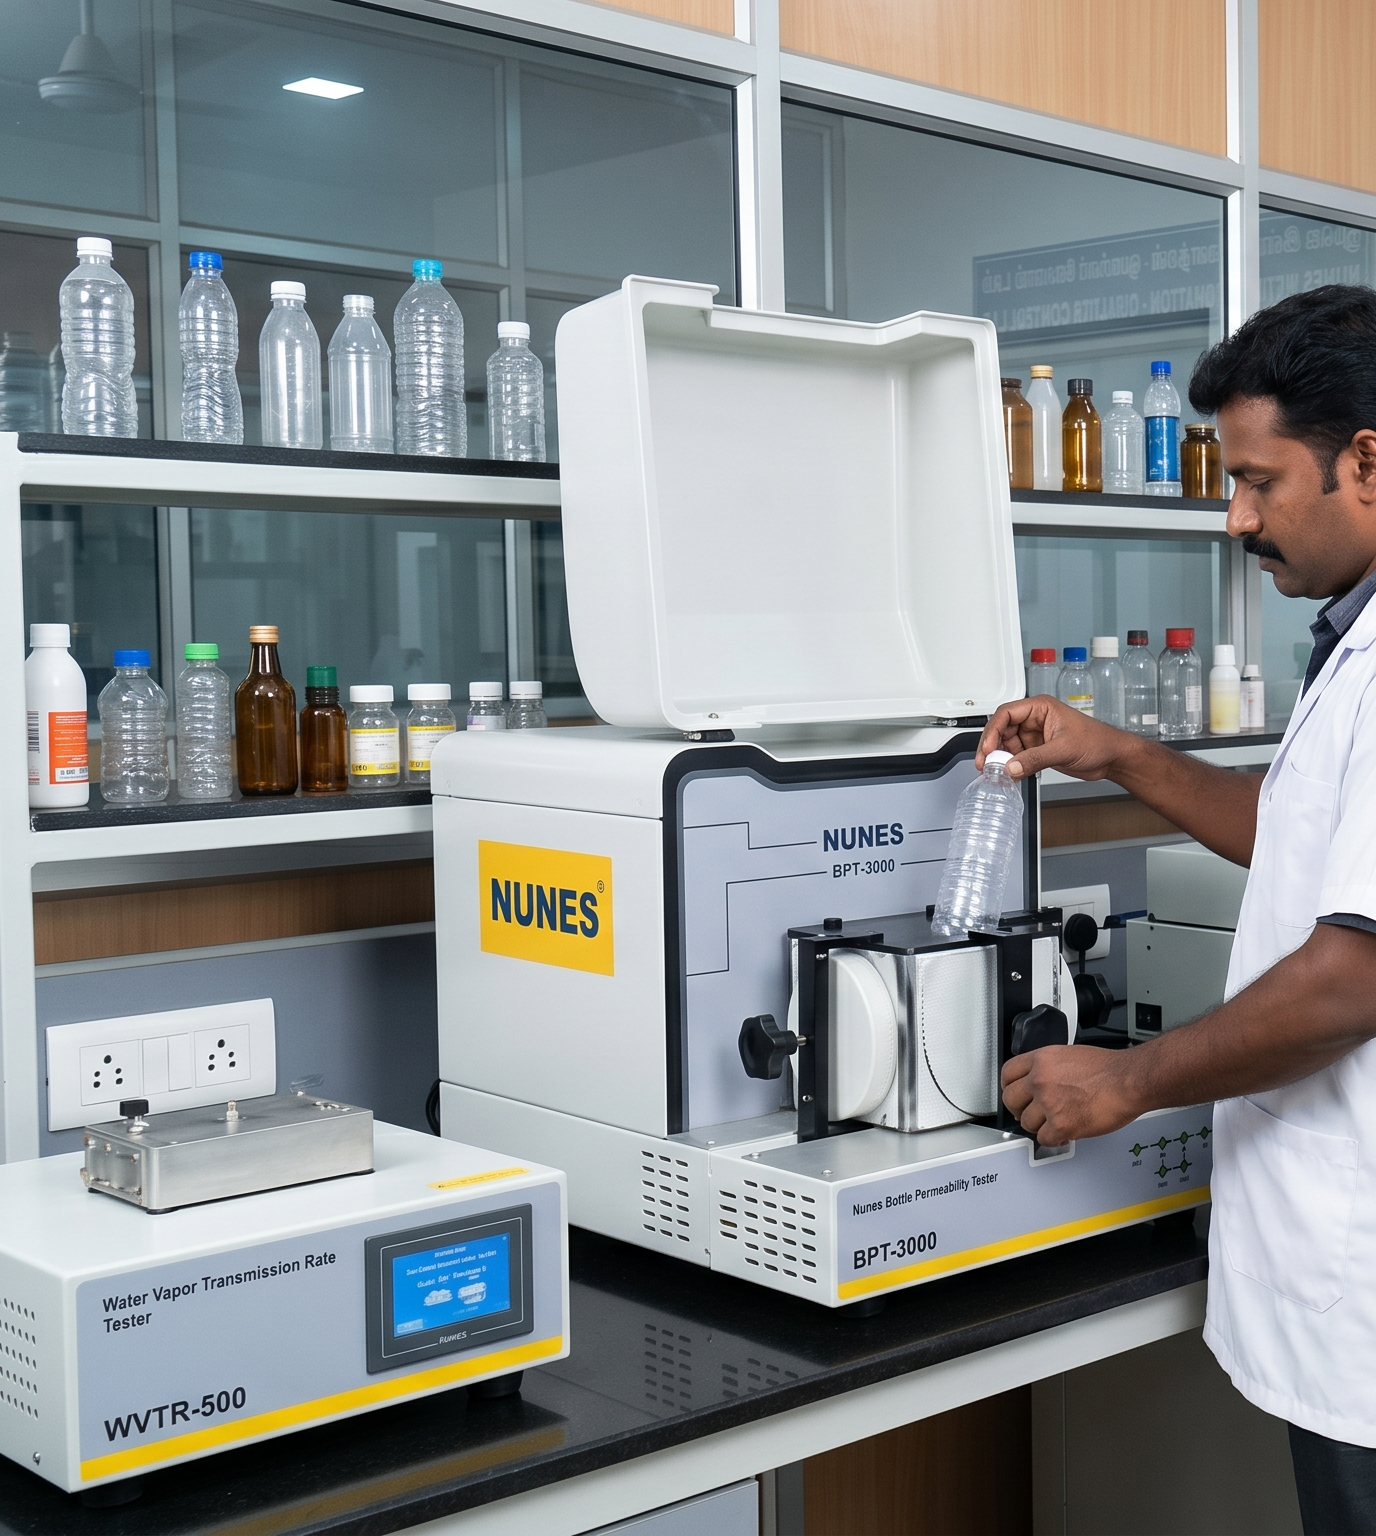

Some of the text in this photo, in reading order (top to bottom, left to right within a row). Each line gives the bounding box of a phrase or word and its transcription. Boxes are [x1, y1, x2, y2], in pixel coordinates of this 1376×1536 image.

[823, 823, 904, 853] NUNES
[832, 858, 895, 879] BPT-3000
[491, 877, 599, 939] NUNES
[852, 1173, 999, 1216] Nunes Bottle Permeability Tester
[853, 1231, 937, 1270] BPT-3000
[102, 1251, 337, 1313] Water Vapor Transmission Rate
[103, 1312, 152, 1333] Tester
[103, 1386, 247, 1442] WVTR-500
